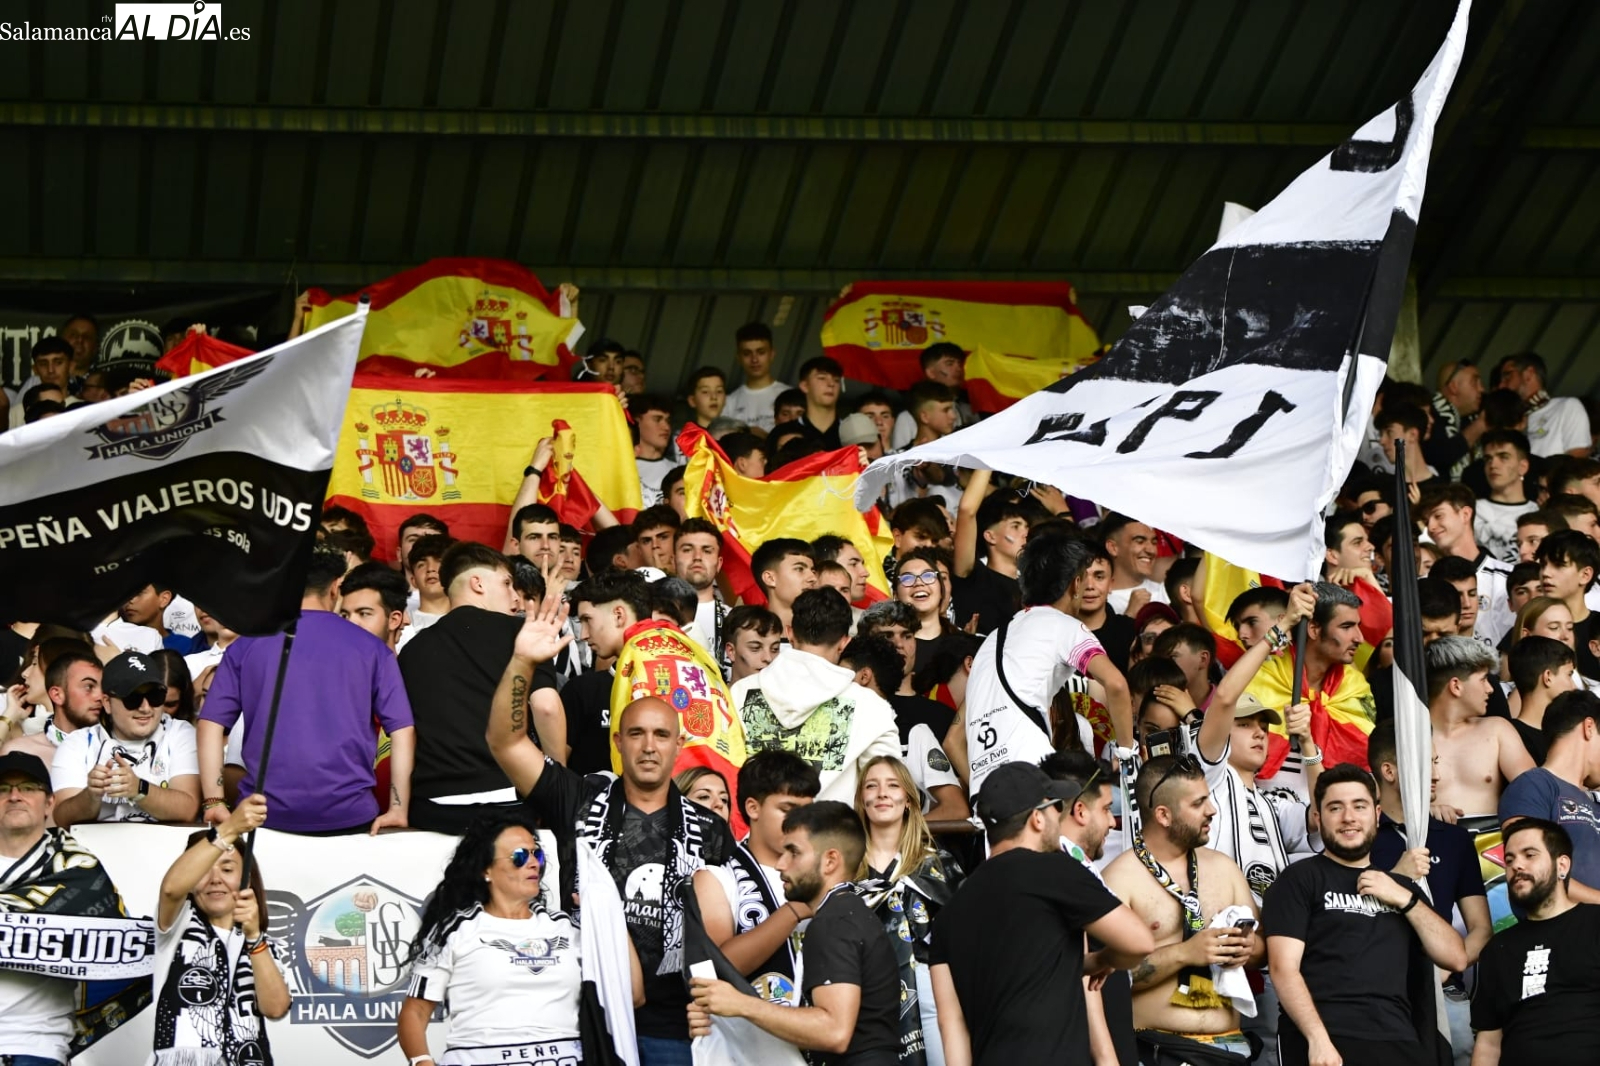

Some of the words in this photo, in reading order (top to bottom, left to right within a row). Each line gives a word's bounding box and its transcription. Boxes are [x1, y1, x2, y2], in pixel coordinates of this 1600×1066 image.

[154, 420, 206, 444] UNION
[0, 515, 92, 550] PEÑA
[97, 476, 254, 532] VIAJEROS
[261, 487, 313, 532] UDS
[70, 928, 148, 965] UDS
[50, 965, 87, 976] SOLA
[298, 1002, 358, 1021] HALA
[501, 1044, 559, 1060] PEÑA
